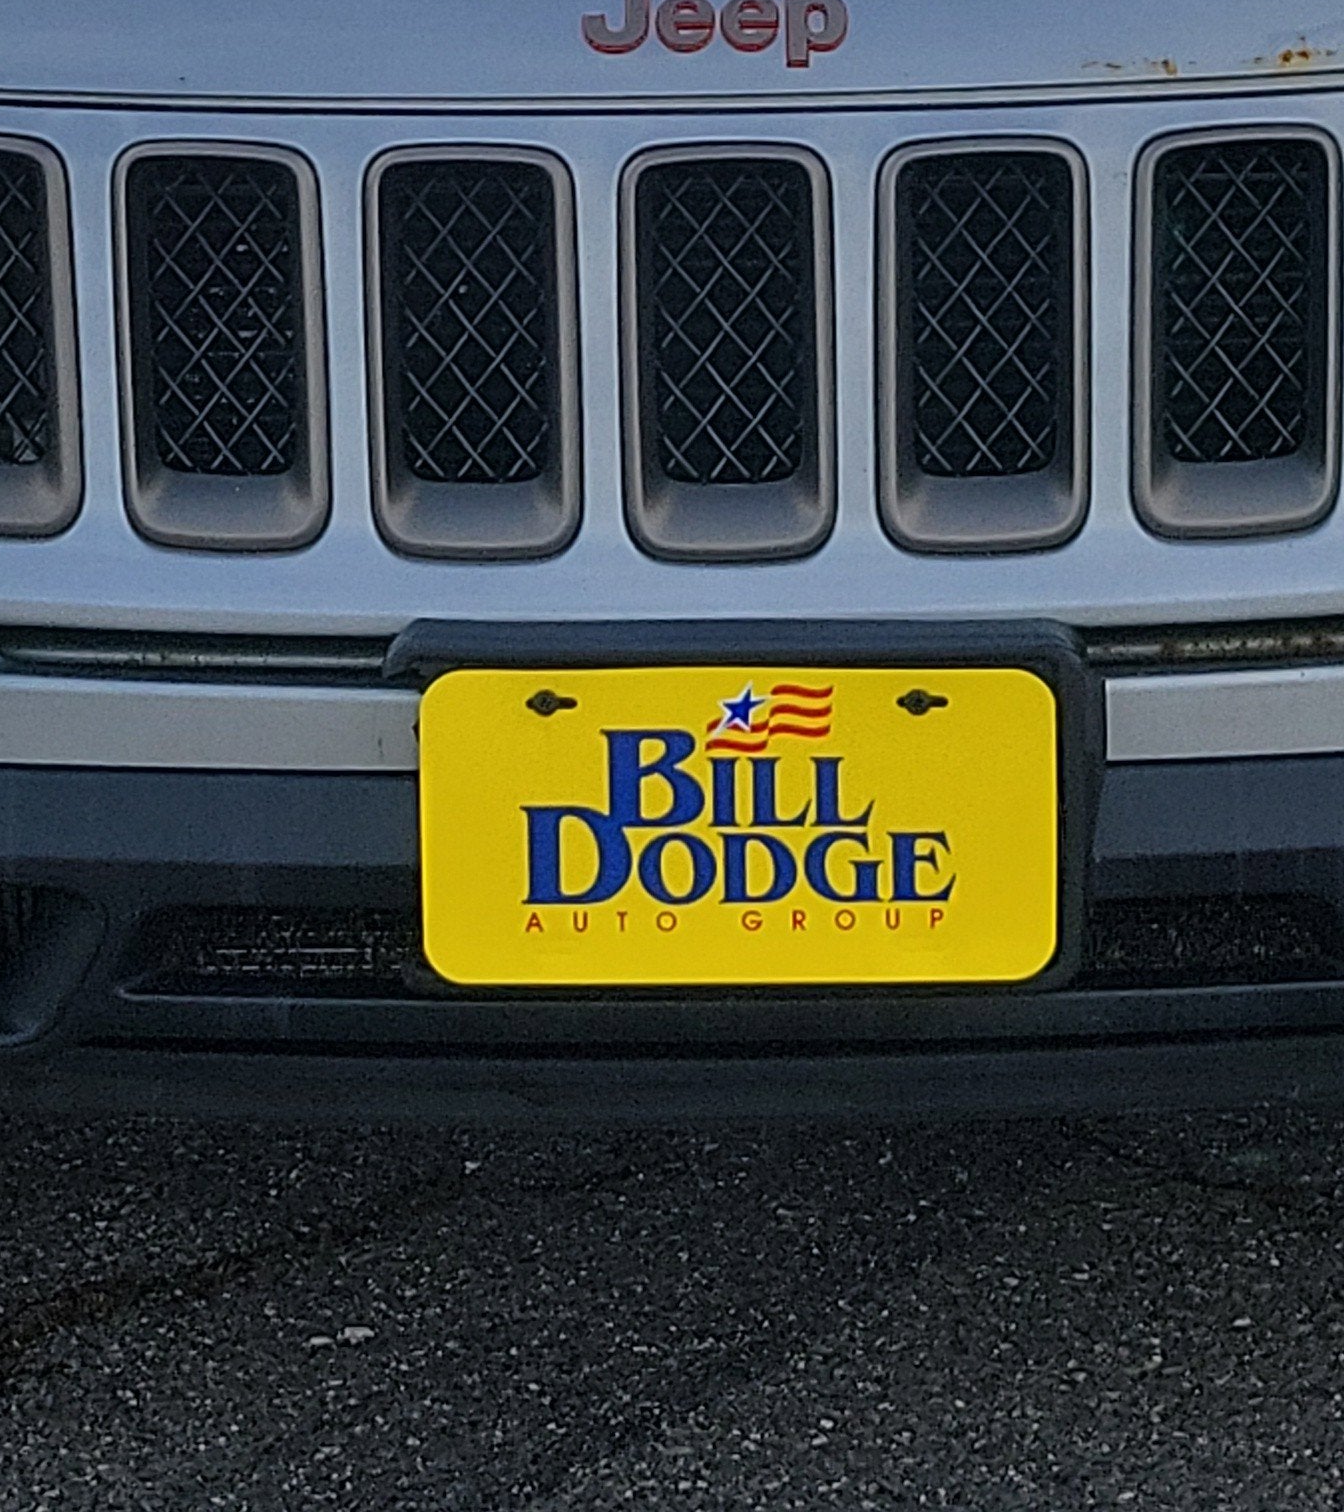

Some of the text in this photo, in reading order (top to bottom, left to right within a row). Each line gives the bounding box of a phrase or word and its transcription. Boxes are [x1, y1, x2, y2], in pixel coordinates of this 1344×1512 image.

[600, 728, 876, 829] BILL
[520, 805, 957, 905] DODGE
[524, 909, 945, 934] AUTO GROUP
